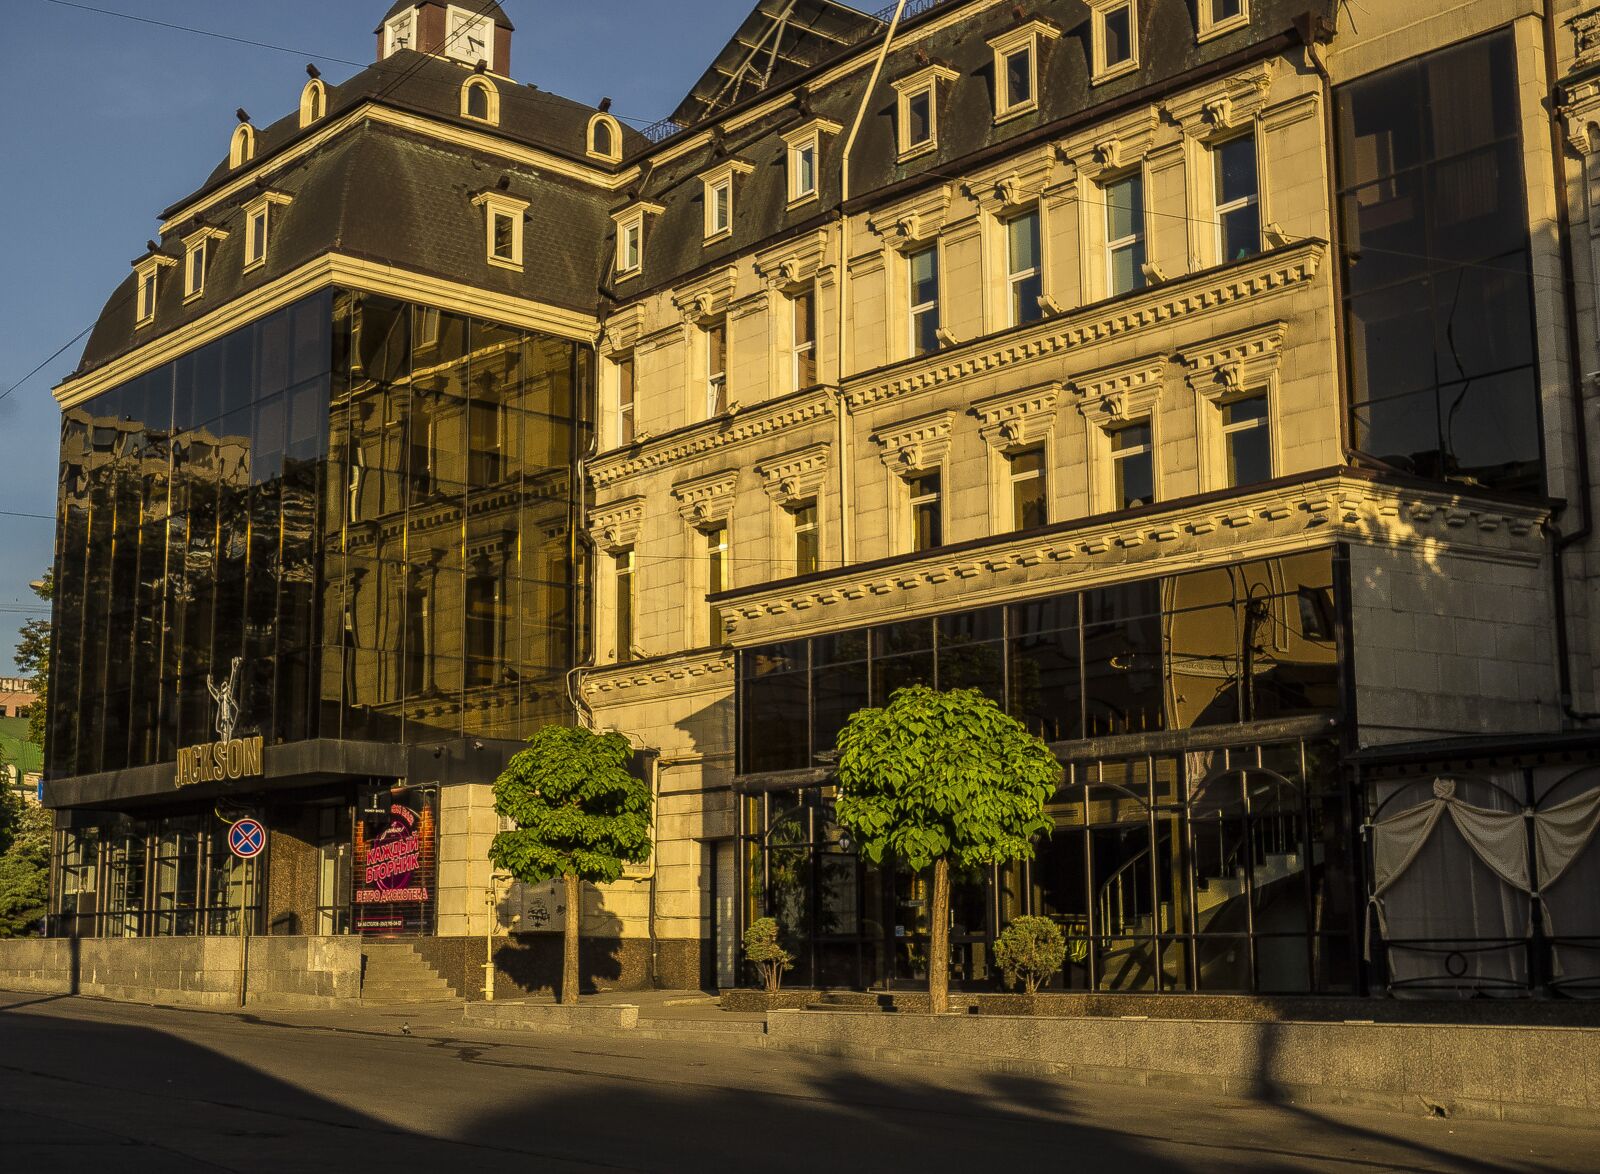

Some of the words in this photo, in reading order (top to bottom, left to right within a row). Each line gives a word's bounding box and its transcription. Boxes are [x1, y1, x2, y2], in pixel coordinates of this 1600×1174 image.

[175, 735, 263, 789] JACKSON
[366, 831, 419, 865] КАЖДЫЙ
[366, 852, 419, 883] ВТОРНИК
[356, 889, 380, 902] РЕТРО
[380, 888, 428, 902] ДИСКОТЕКА
